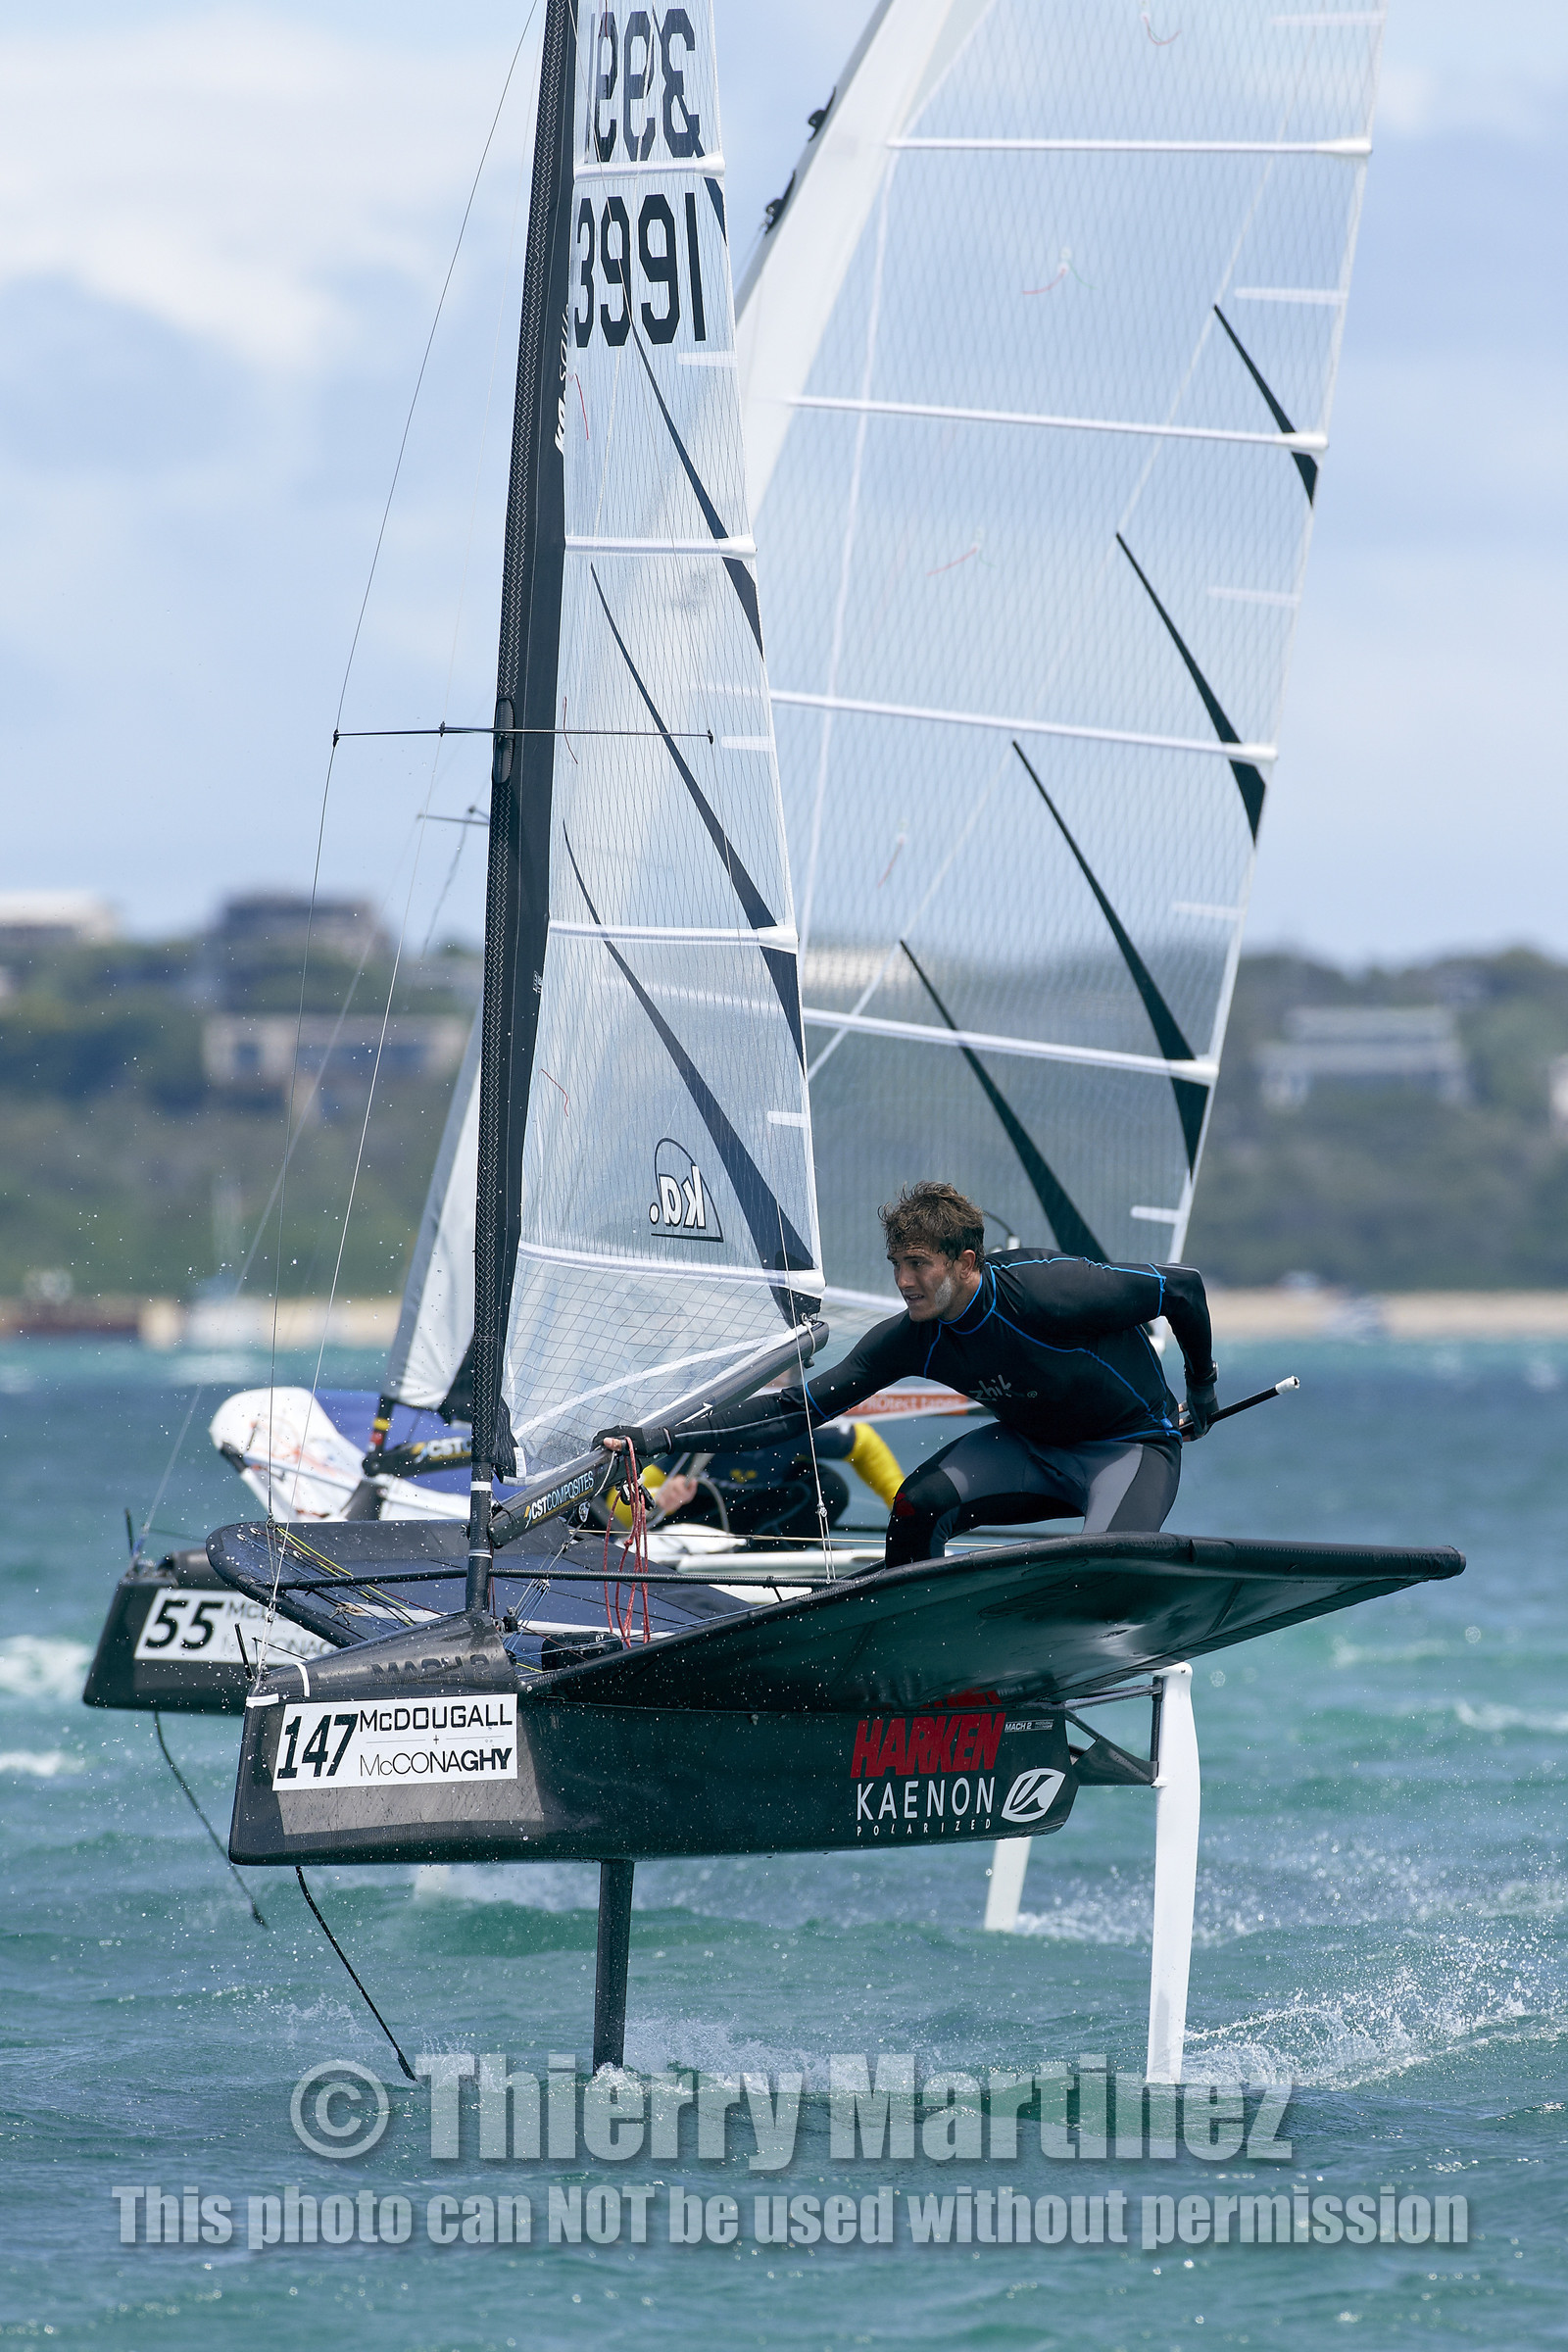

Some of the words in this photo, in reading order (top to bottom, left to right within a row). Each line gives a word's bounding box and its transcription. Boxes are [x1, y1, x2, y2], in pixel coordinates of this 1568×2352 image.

[574, 192, 706, 348] 3991
[145, 1599, 223, 1650] 55
[360, 1703, 513, 1733] McDOUGALL
[1004, 1722, 1026, 1731] MACH
[276, 1713, 359, 1779] 147
[360, 1747, 513, 1777] McCONAGHY
[851, 1713, 1006, 1778] HARKEN
[857, 1777, 996, 1821] KAENON
[857, 1818, 991, 1837] POLARIZED
